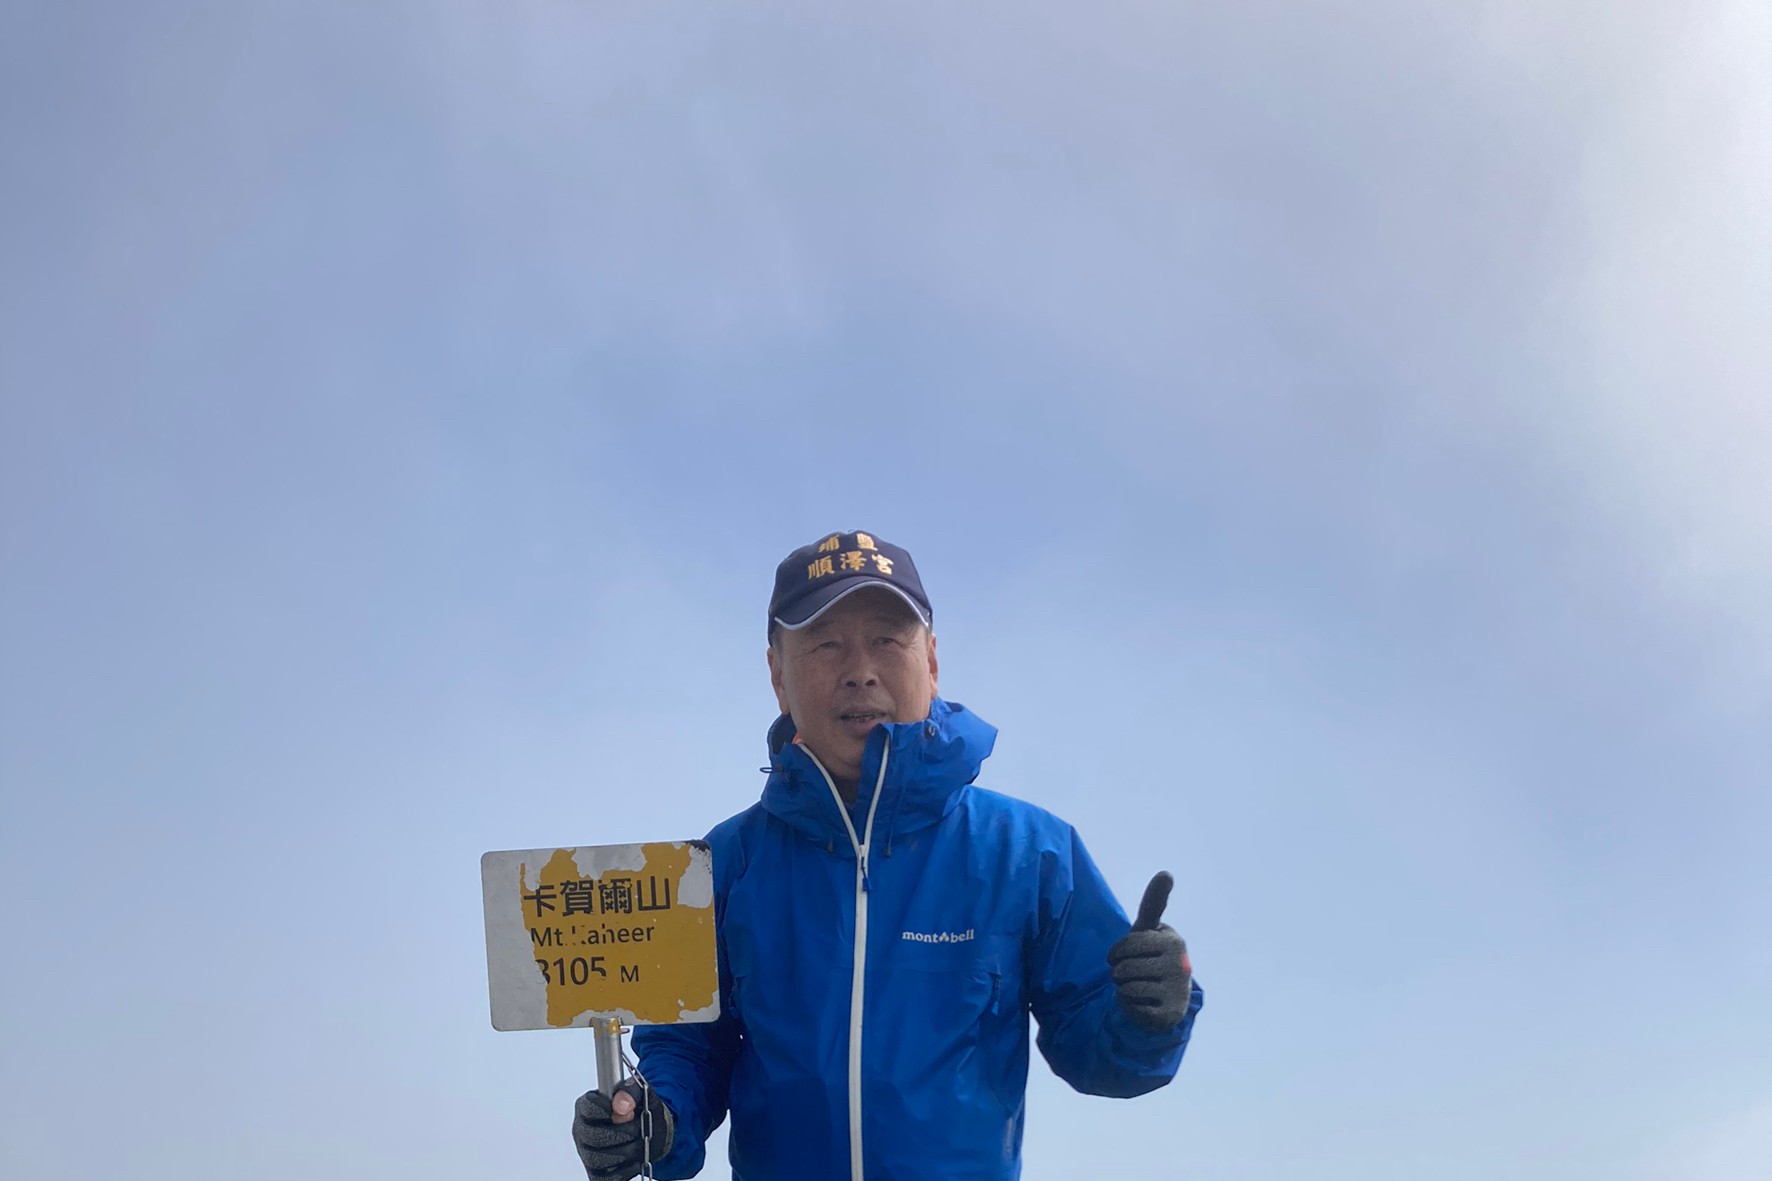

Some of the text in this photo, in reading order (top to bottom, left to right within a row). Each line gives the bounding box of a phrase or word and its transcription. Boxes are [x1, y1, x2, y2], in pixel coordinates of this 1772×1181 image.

[523, 875, 671, 918] 卡賀爾山
[620, 964, 640, 983] M
